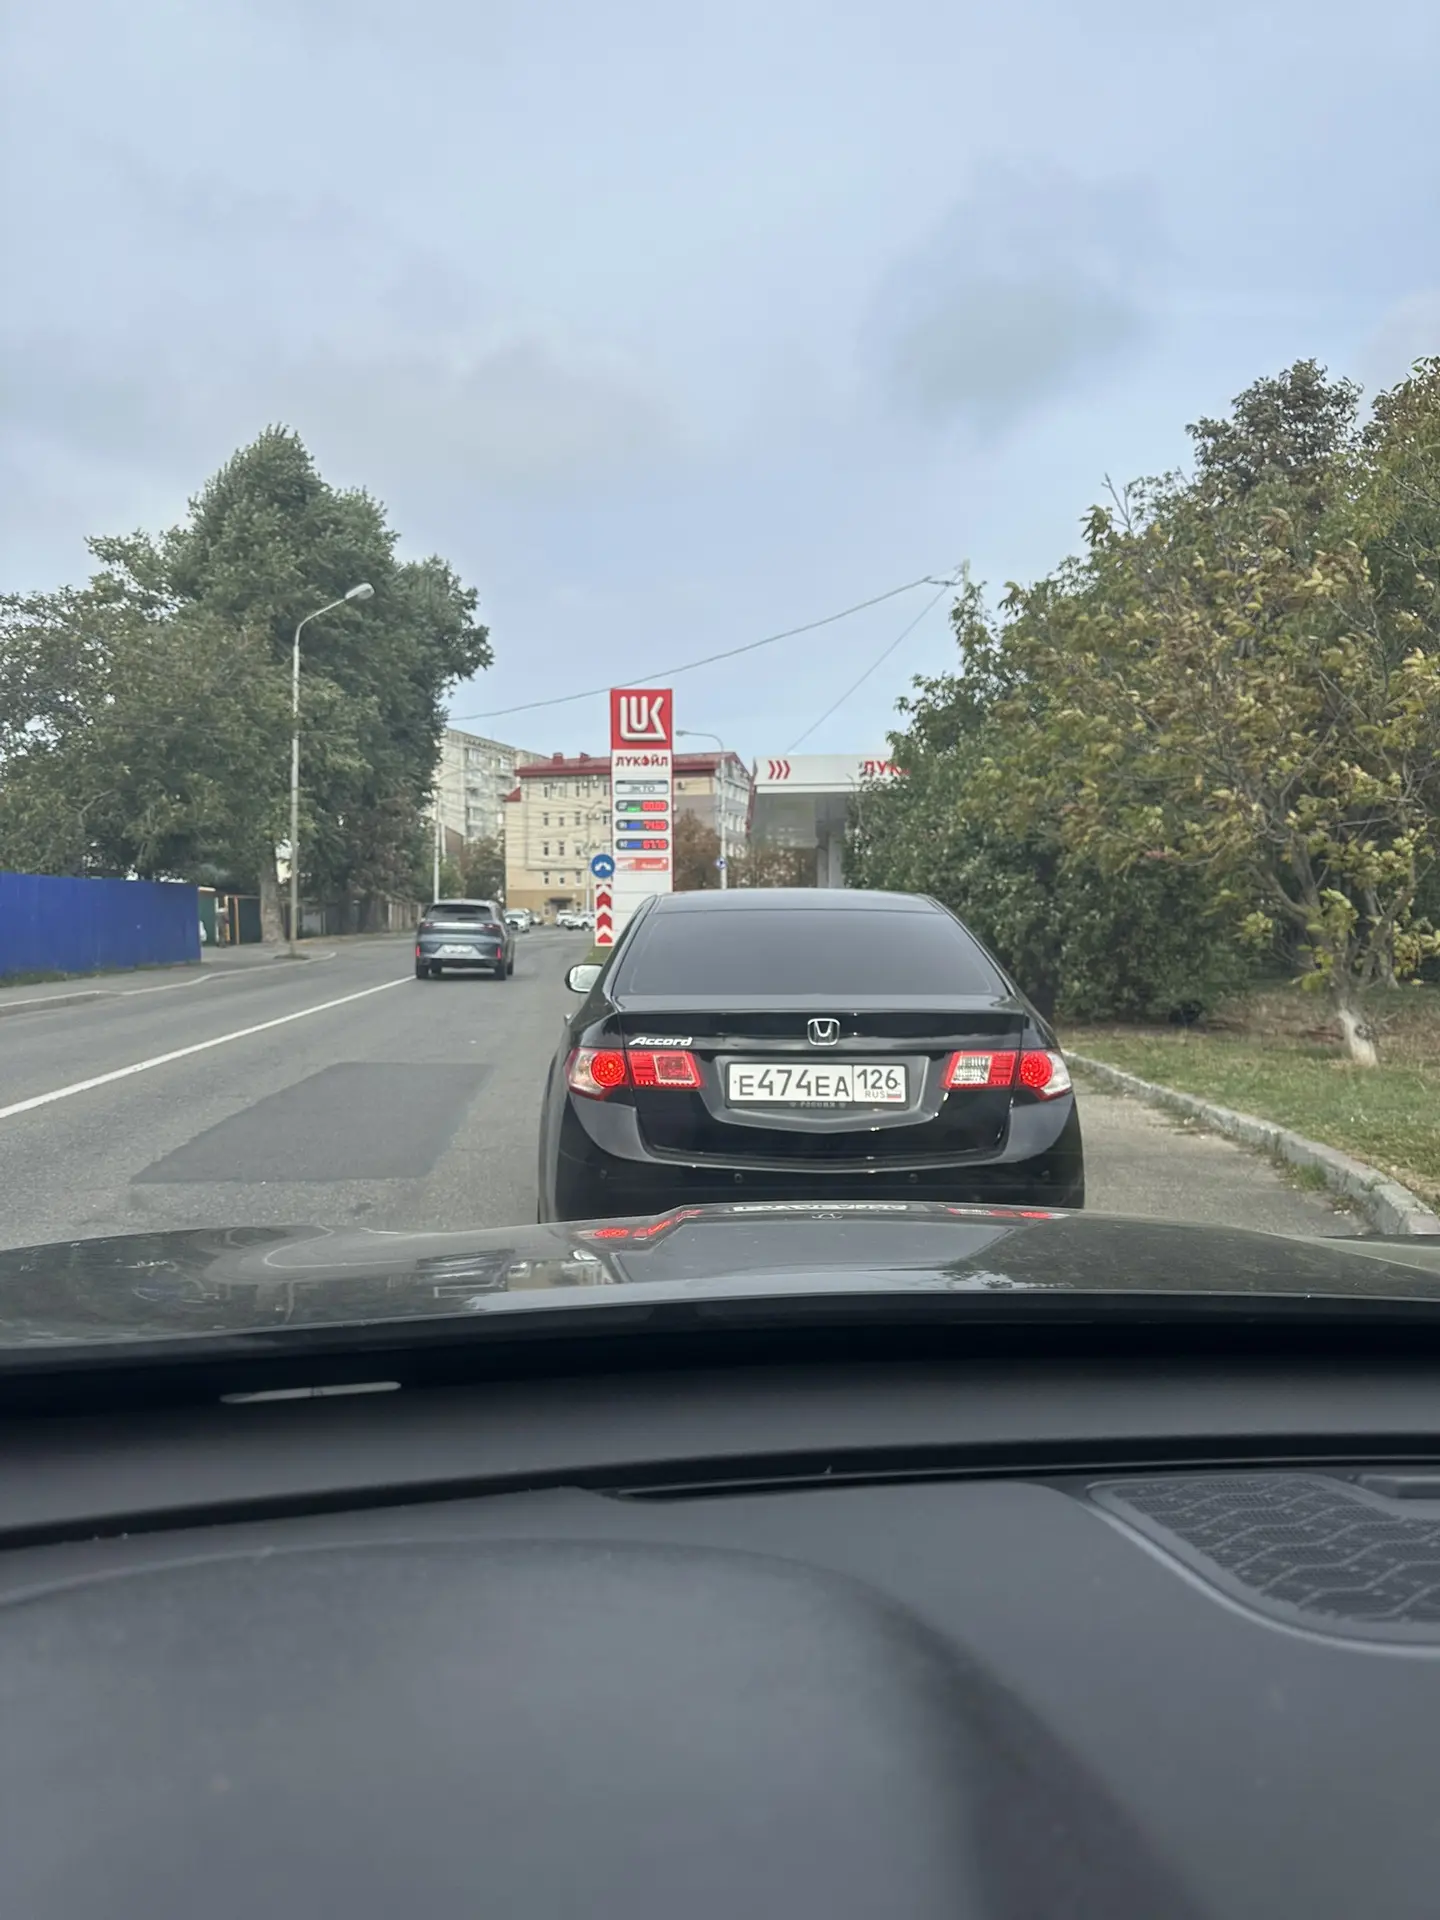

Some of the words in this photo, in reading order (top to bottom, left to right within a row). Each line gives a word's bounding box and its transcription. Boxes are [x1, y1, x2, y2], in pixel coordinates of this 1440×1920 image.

[616, 754, 668, 767] ЛУКОЙЛ
[859, 760, 911, 776] ЛУК
[629, 1036, 693, 1047] Accord
[738, 1069, 850, 1097] Е474ЕА
[857, 1069, 899, 1090] 126
